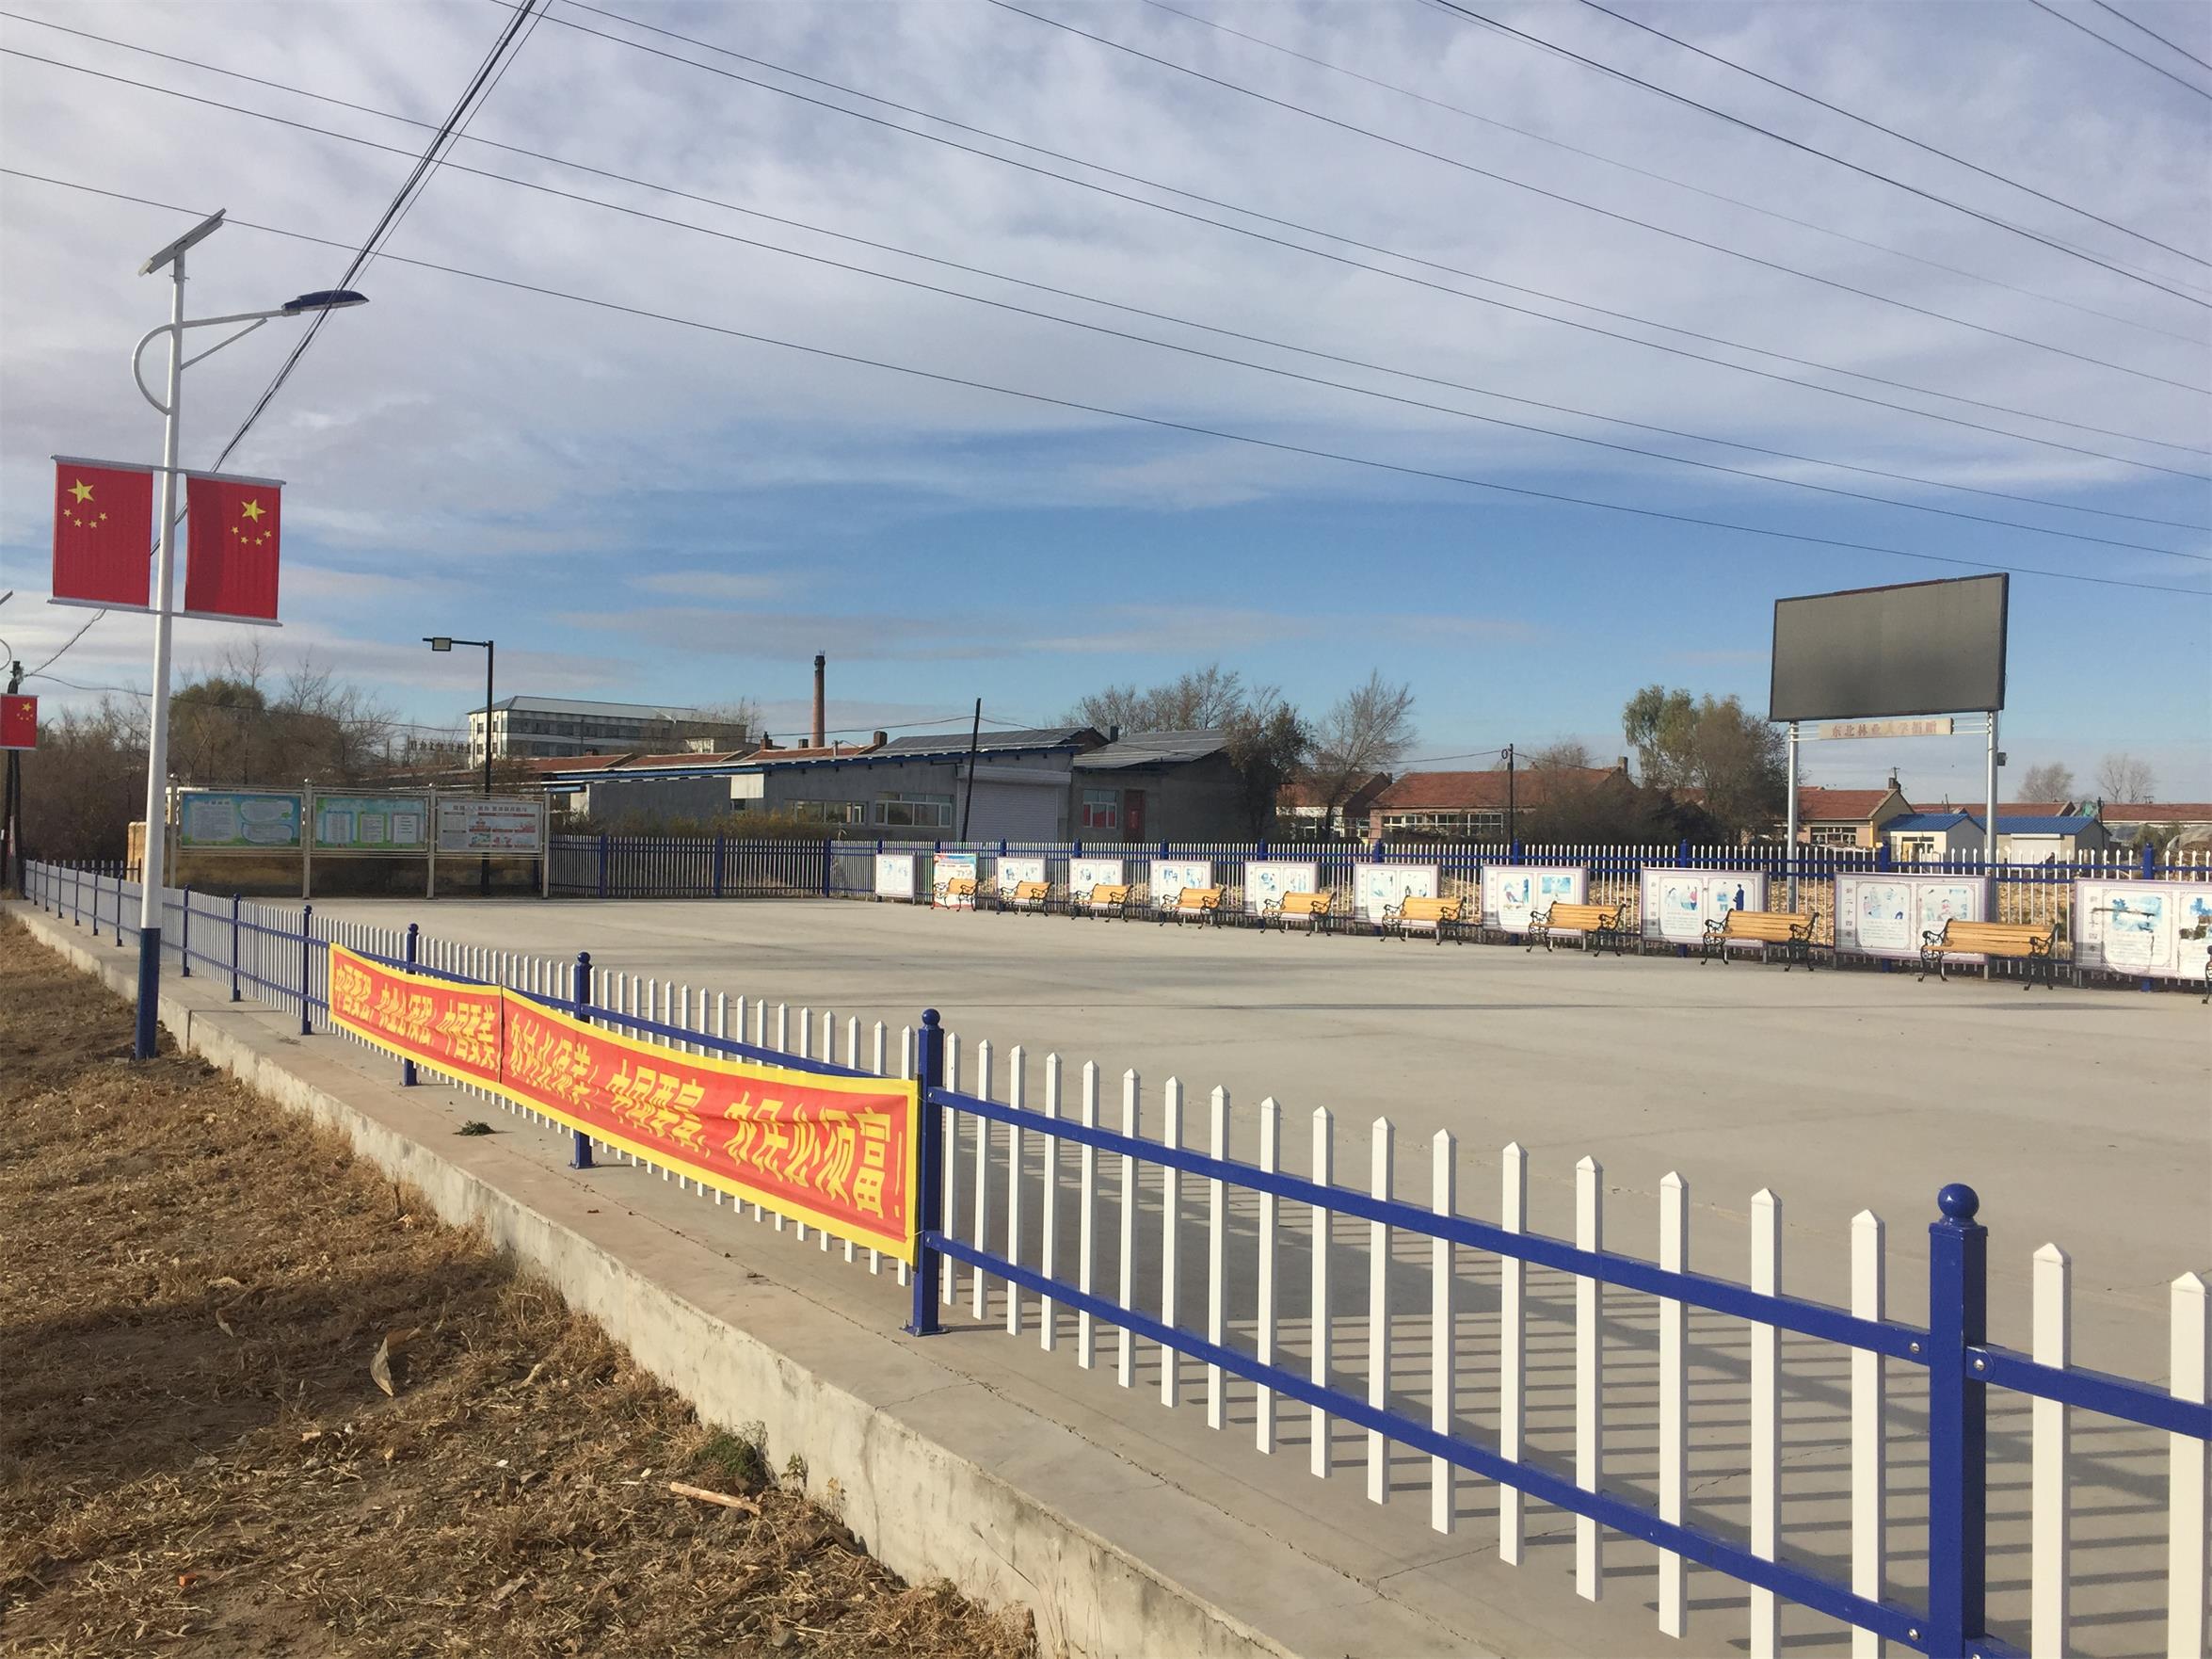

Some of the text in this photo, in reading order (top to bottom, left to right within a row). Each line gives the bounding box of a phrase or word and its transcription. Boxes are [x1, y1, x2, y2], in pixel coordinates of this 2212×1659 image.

[1832, 720, 1937, 738] 东北林业大学捐赠
